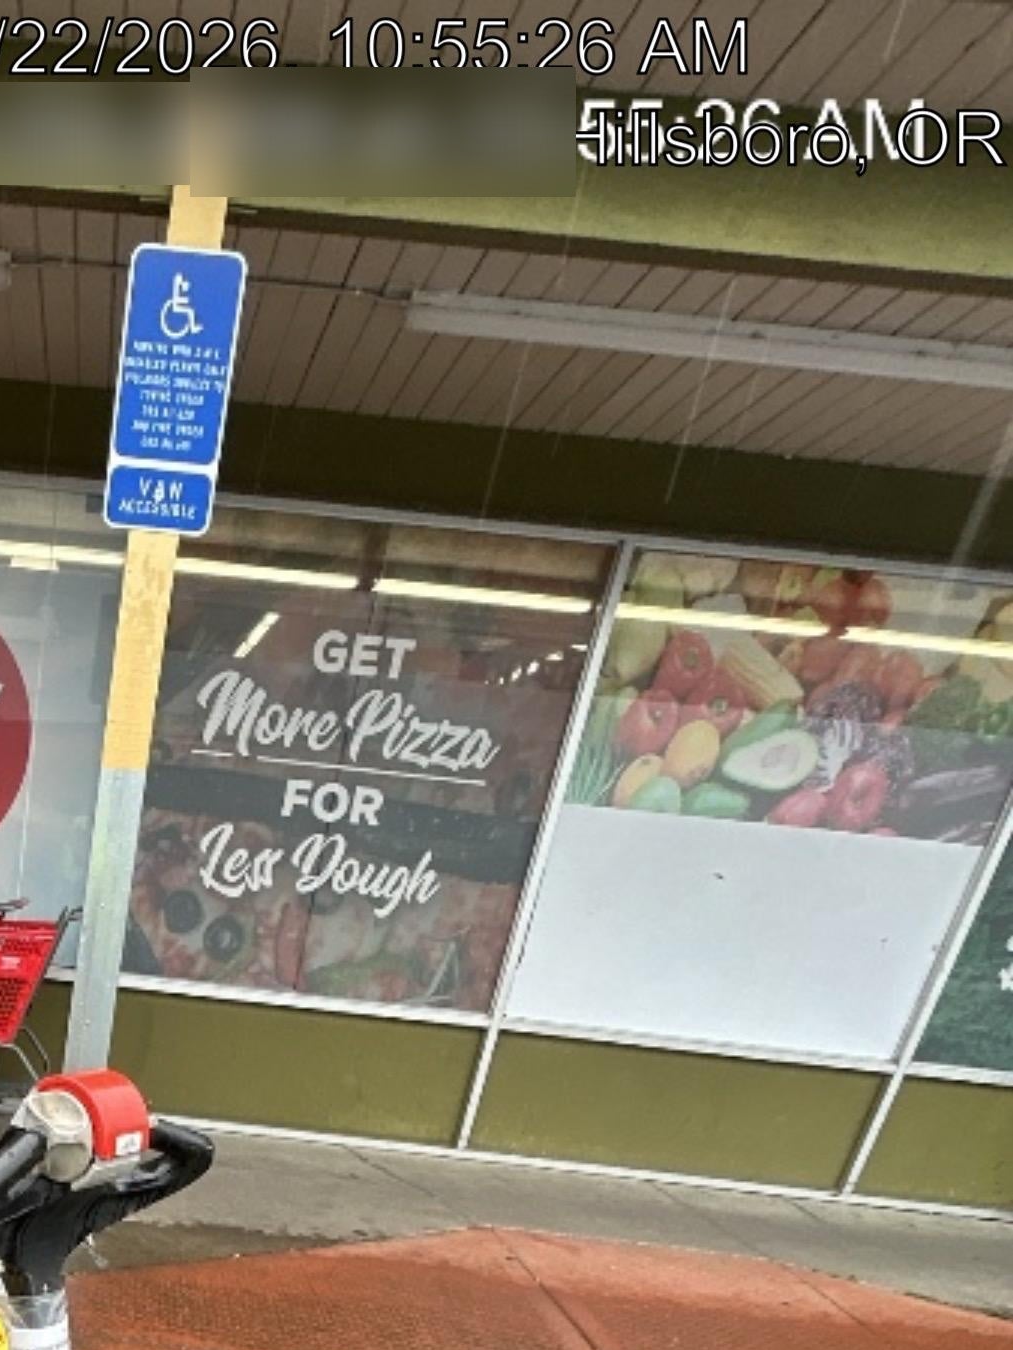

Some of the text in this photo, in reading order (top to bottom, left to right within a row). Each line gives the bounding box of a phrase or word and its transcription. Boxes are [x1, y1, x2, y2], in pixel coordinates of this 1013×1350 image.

[313, 629, 417, 679] GET
[196, 670, 501, 771] More Pizza
[281, 779, 384, 826] FOR
[199, 822, 441, 919] Less Dough
